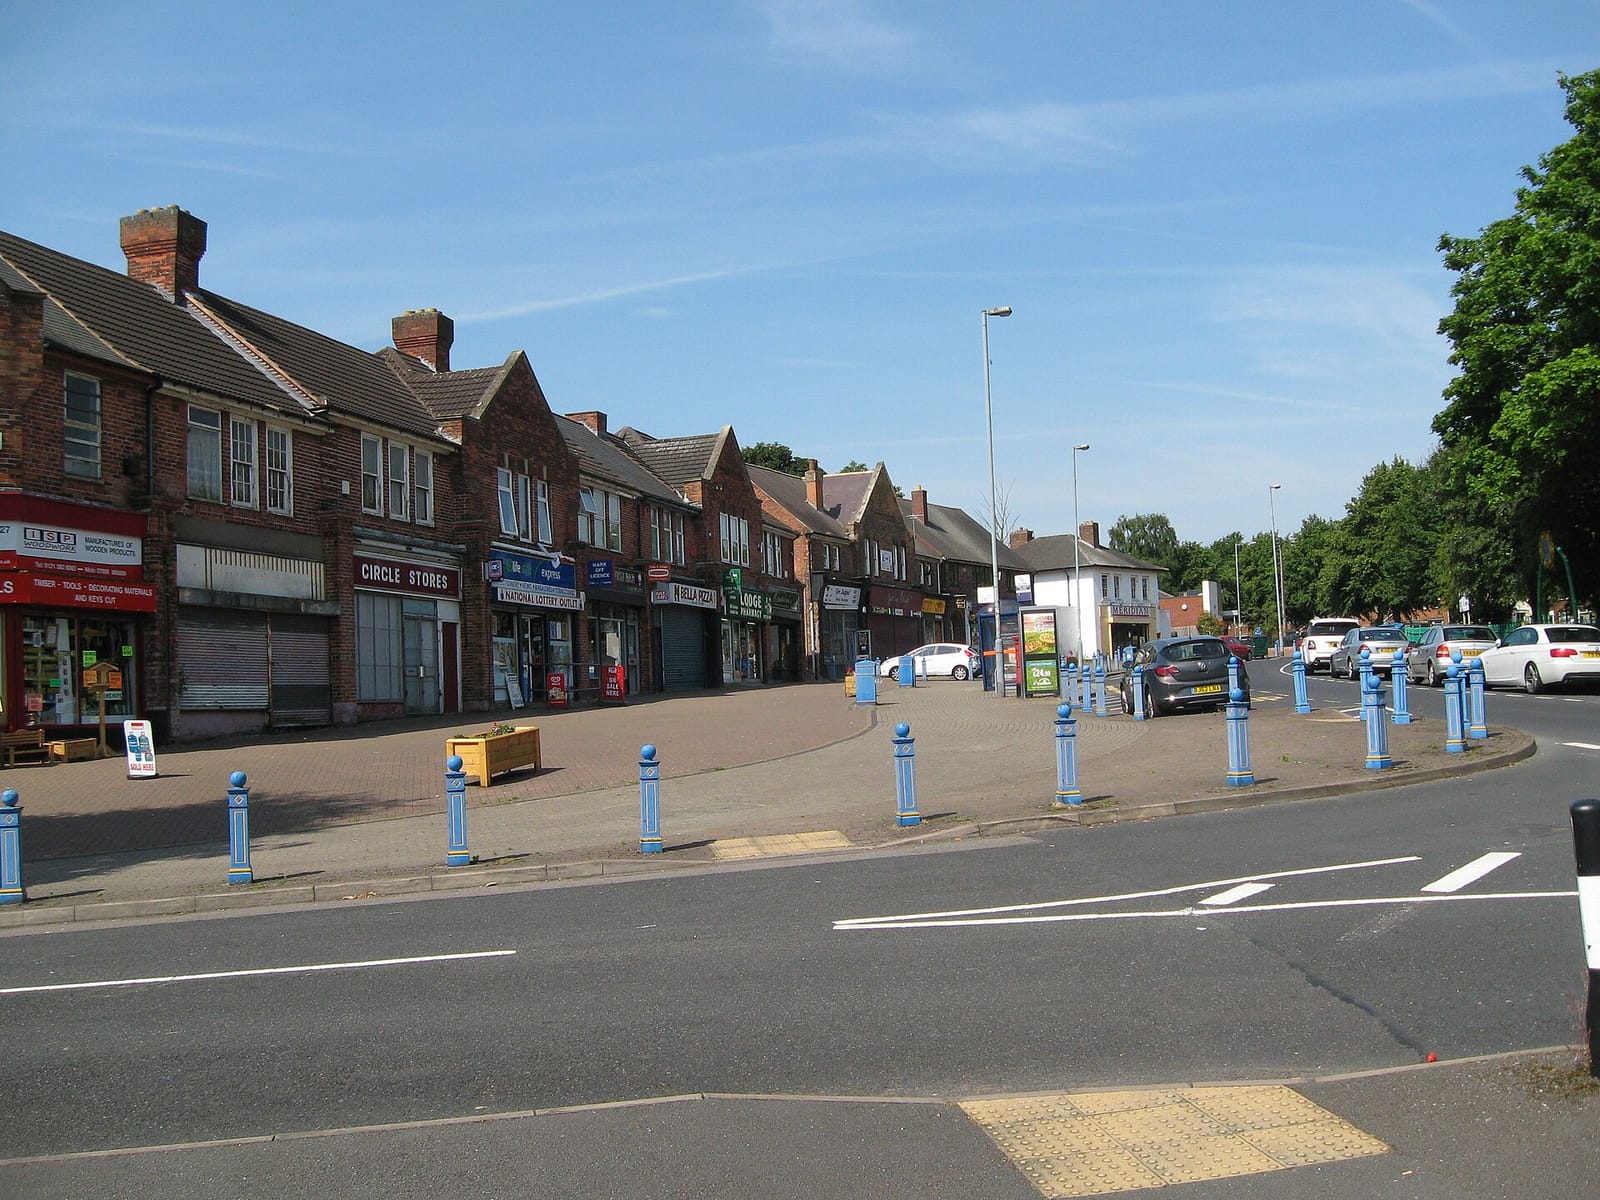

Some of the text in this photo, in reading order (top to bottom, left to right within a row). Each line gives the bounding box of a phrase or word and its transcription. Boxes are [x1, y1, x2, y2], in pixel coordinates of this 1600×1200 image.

[24, 540, 76, 552] WOODWORK
[85, 537, 125, 549] MANUFACTURES
[85, 545, 136, 557] WOODEN PRODUCTS
[362, 563, 448, 590] CIRCLE STORES
[541, 568, 561, 581] express
[34, 578, 153, 596] TIMBER TOOLS DECORATING MATERIALS
[75, 594, 87, 602] AND
[88, 595, 103, 604] KEYS
[505, 590, 578, 609] NATIONAL LOTTERY OUTLET
[681, 586, 698, 601] BELLA
[699, 590, 713, 603] PIZZA
[740, 593, 762, 609] LODGE
[740, 607, 762, 619] PHARMACY
[1112, 606, 1149, 615] MERIDIAN
